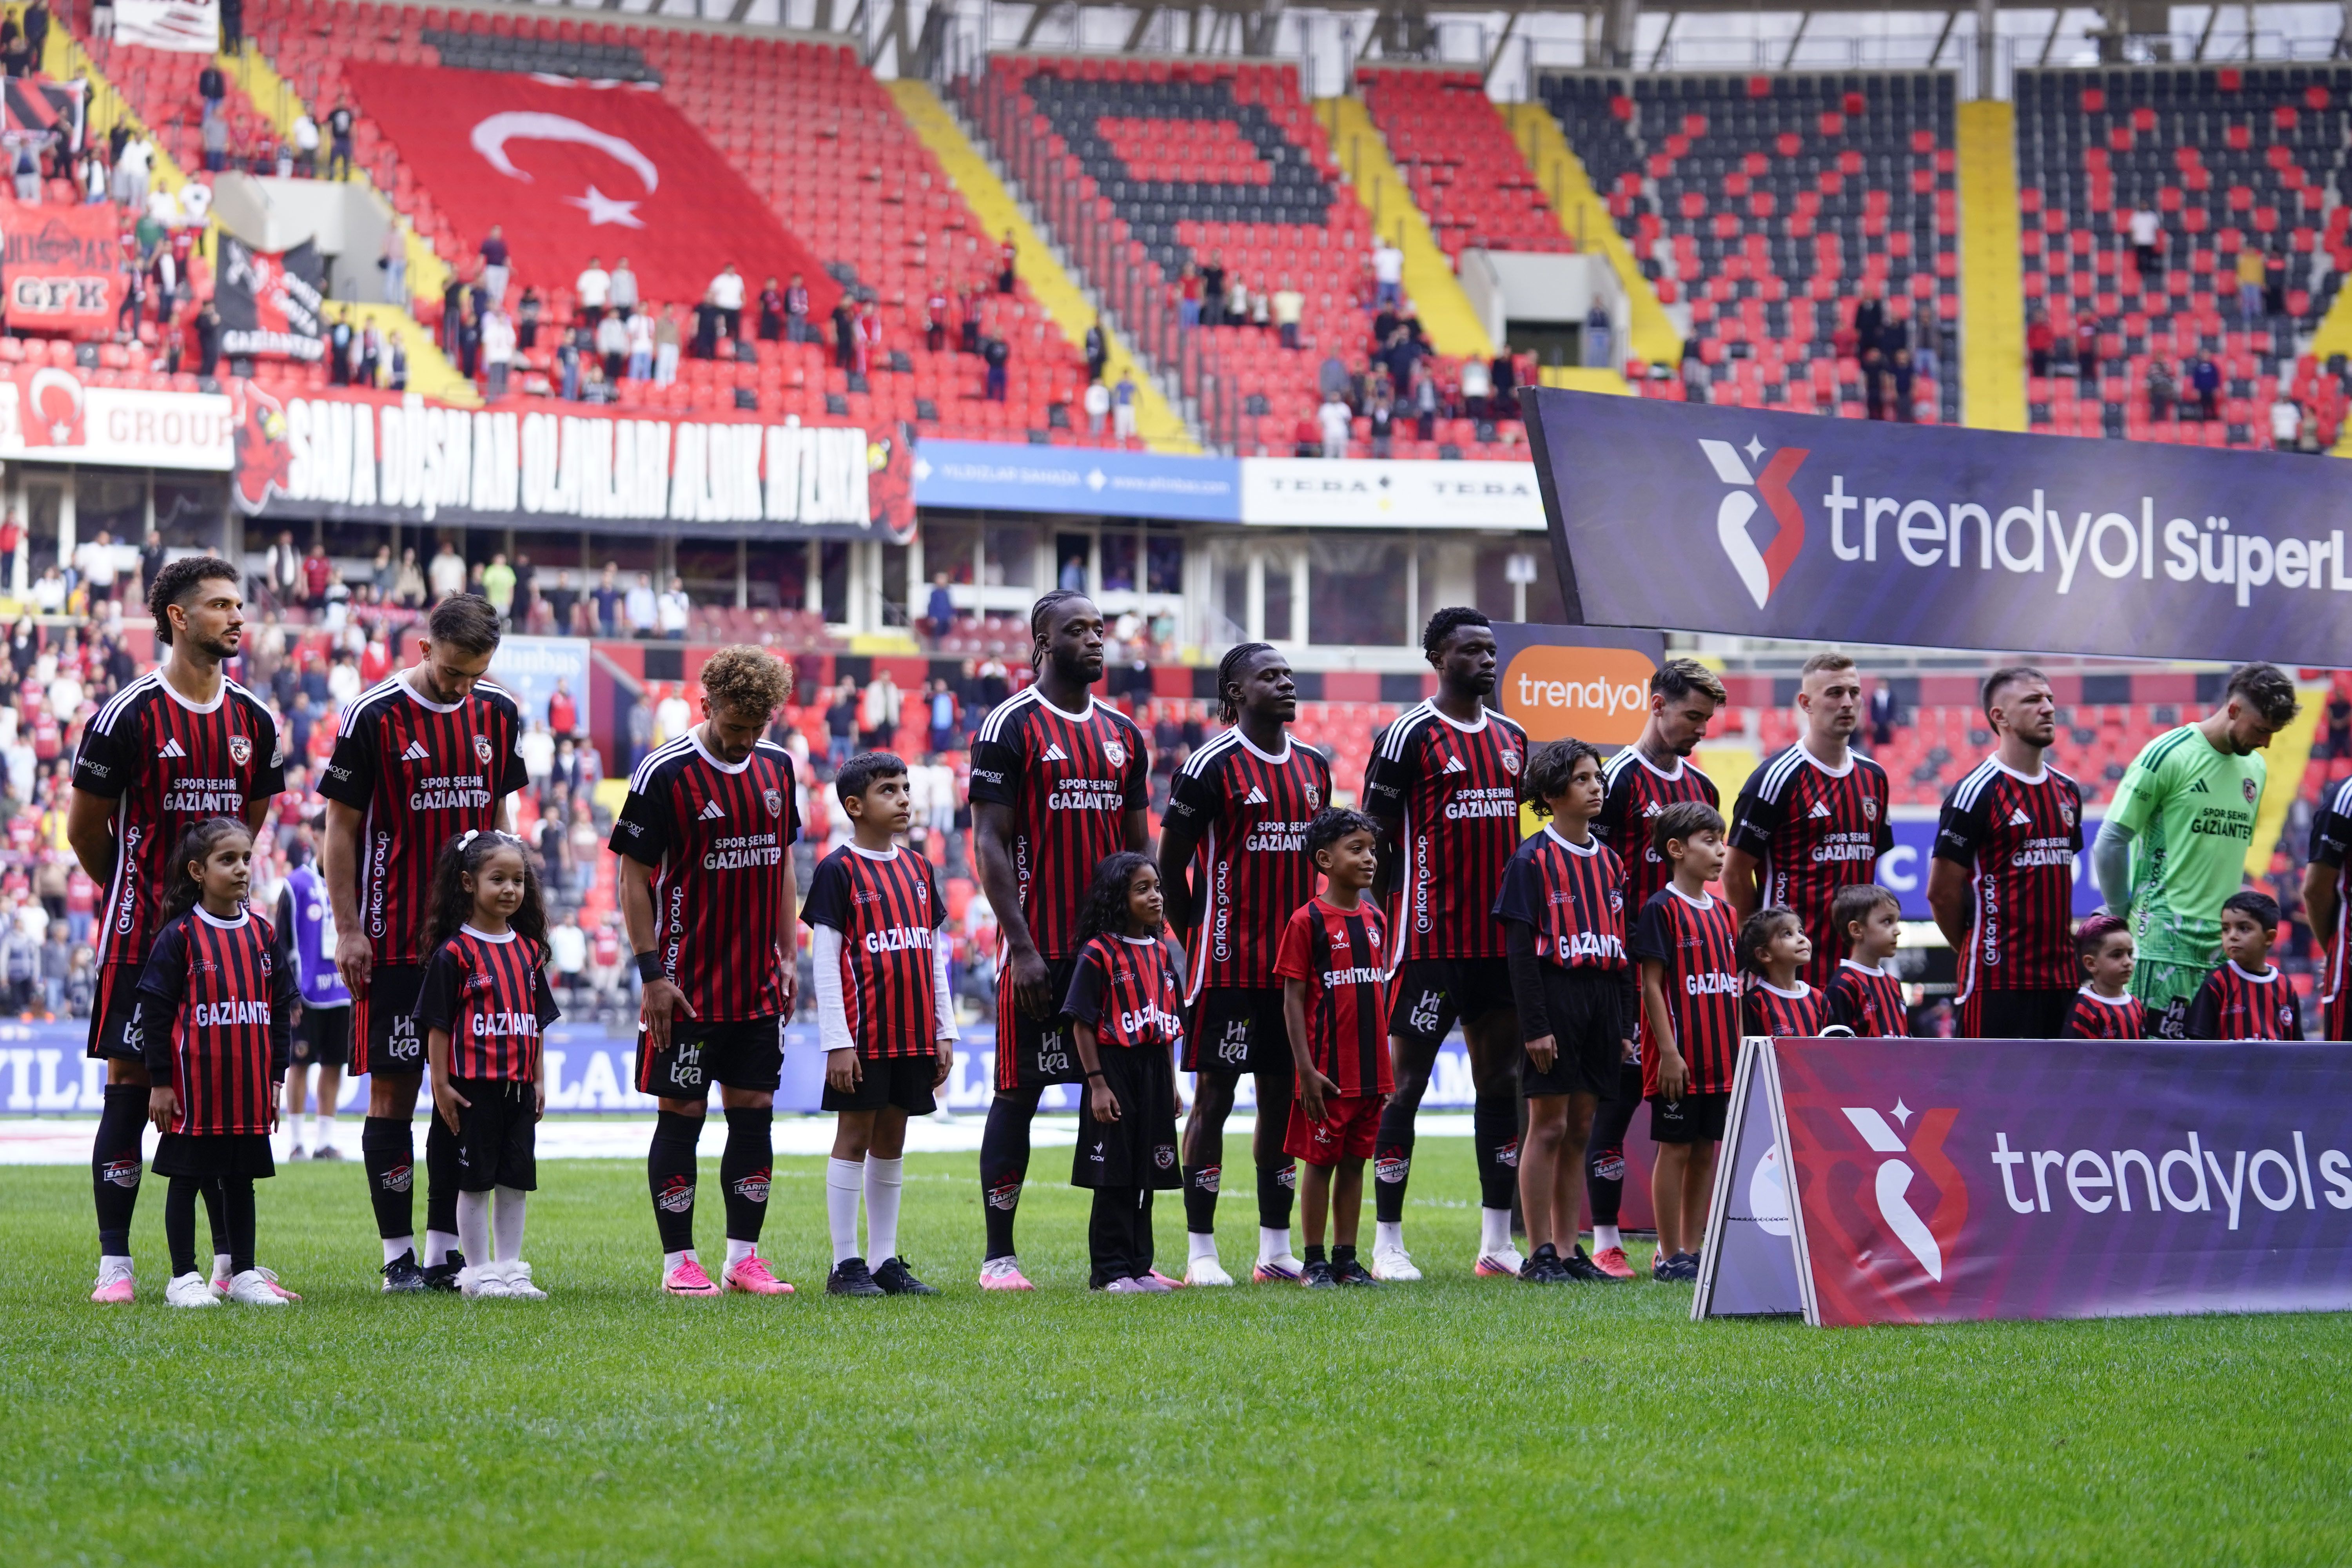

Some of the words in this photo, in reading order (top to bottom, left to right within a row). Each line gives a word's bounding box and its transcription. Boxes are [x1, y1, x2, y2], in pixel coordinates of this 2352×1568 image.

[13, 278, 108, 313] GFK
[381, 393, 517, 520] DÜŞMAN
[1270, 477, 1368, 493] TEBA
[1431, 481, 1532, 497] TEBA
[1823, 474, 2153, 594] trendyol
[1518, 672, 1650, 715] trendyol
[326, 764, 350, 777] MOOD
[174, 778, 206, 790] SPOR
[420, 778, 450, 789] SPOR
[1059, 779, 1088, 789] SPOR
[1456, 789, 1485, 800] SPOR
[2203, 808, 2225, 817] SPOR
[1257, 822, 1285, 832] SPOR
[1289, 822, 1314, 835] ŞEH
[1588, 822, 1609, 831] MOOD
[1824, 833, 1847, 843] SPOR
[127, 826, 142, 872] group
[374, 831, 390, 877] group
[715, 837, 746, 849] SPOR
[1018, 835, 1030, 881] group
[1417, 835, 1430, 878] group
[1217, 861, 1230, 905] group
[1984, 873, 1998, 914] group
[670, 886, 684, 932] group
[866, 923, 932, 953] GAZİANTE
[197, 996, 270, 1027] GAZİANTE
[1420, 990, 1440, 1012] Hi
[473, 1007, 539, 1038] GAZİANTE
[1227, 1021, 1246, 1042] Hi
[1411, 1007, 1439, 1032] tea
[123, 1025, 143, 1051] te
[389, 1036, 419, 1060] tea
[1042, 1031, 1062, 1052] Hi
[678, 1044, 699, 1064] Hi
[1038, 1052, 1069, 1074] tea
[1219, 1039, 1248, 1063] tea
[670, 1062, 702, 1088] tea
[1377, 1161, 1409, 1176] SARIYER
[1992, 1130, 2316, 1230] trendyol
[662, 1188, 694, 1207] SARIYER
